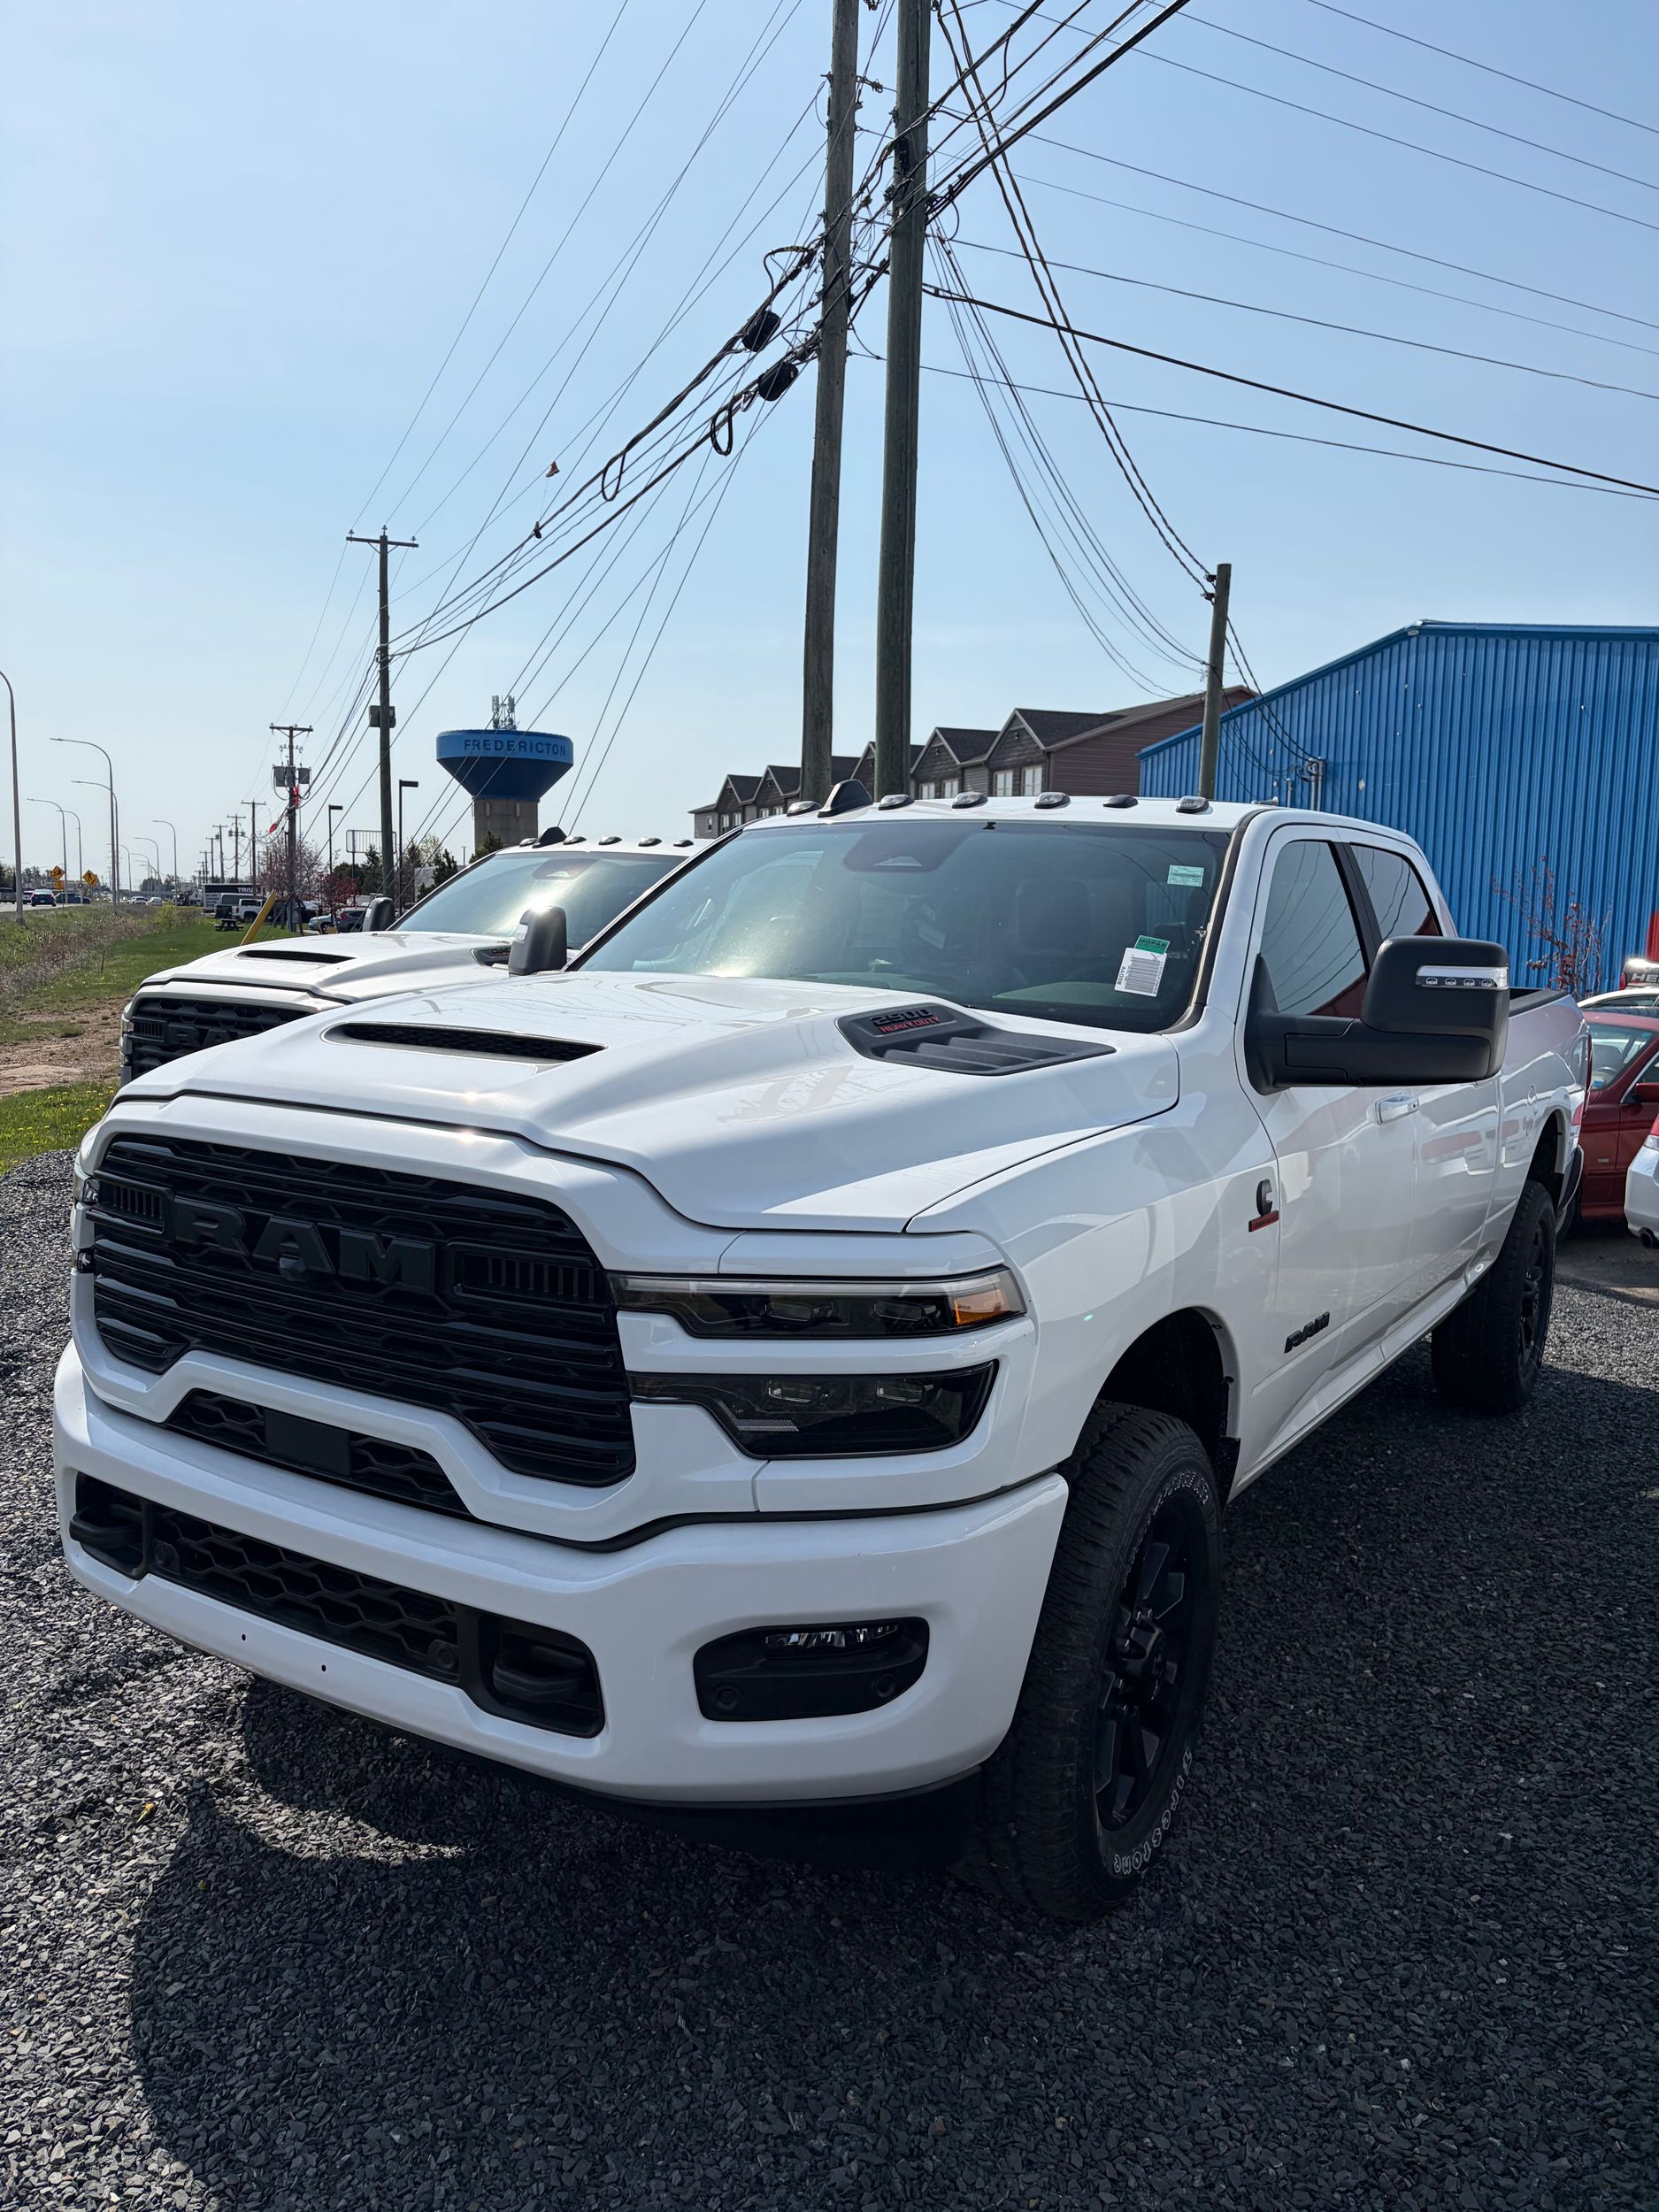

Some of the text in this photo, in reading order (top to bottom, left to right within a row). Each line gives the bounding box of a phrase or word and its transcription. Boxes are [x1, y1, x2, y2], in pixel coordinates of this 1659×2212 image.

[465, 739, 565, 756] FREDERICTON
[1632, 973, 1659, 983] HE
[870, 1009, 934, 1026] 2500
[878, 1016, 941, 1033] HEAVY DUTY
[168, 1022, 250, 1048] RA
[173, 1194, 435, 1293] RAM
[1284, 1310, 1330, 1354] RAM
